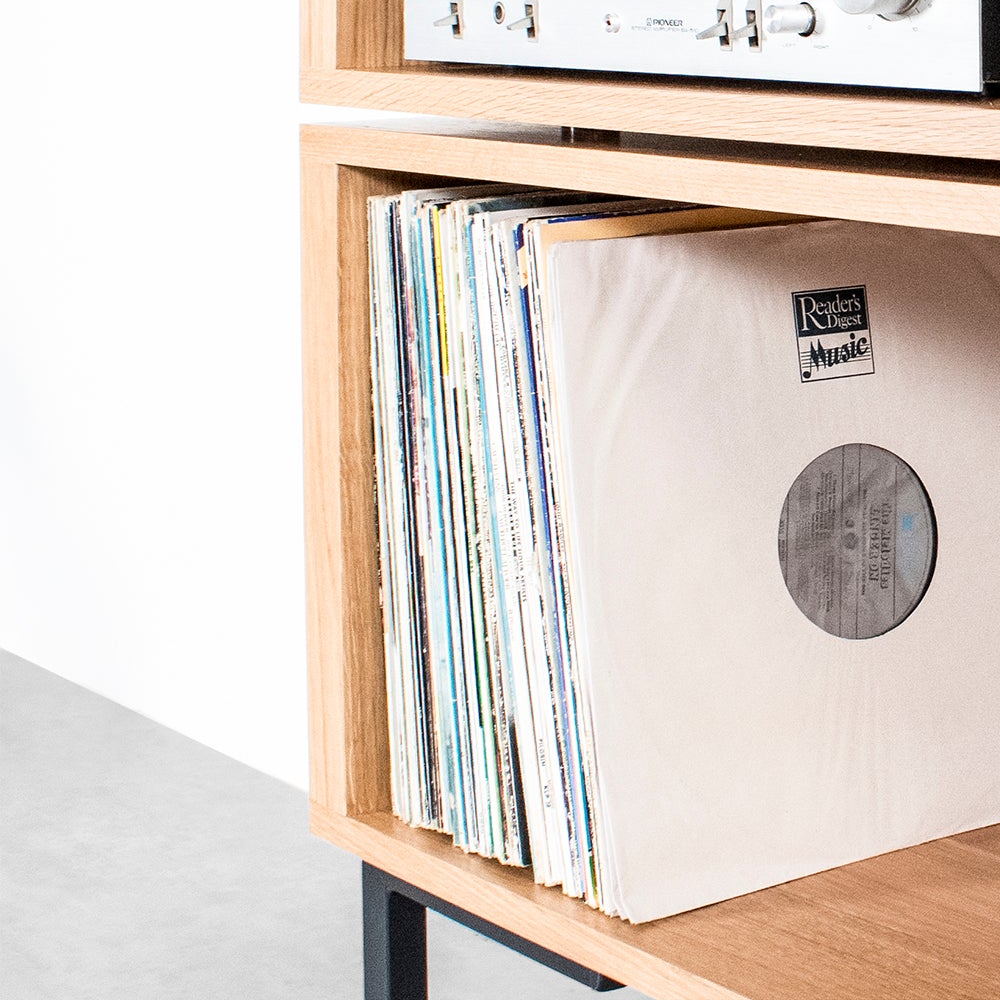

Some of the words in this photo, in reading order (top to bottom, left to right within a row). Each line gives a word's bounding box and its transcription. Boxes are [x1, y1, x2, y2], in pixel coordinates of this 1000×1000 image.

[652, 18, 684, 27] PIONEER
[798, 293, 862, 332] Reader's
[827, 314, 862, 330] Digest
[802, 332, 870, 379] Music
